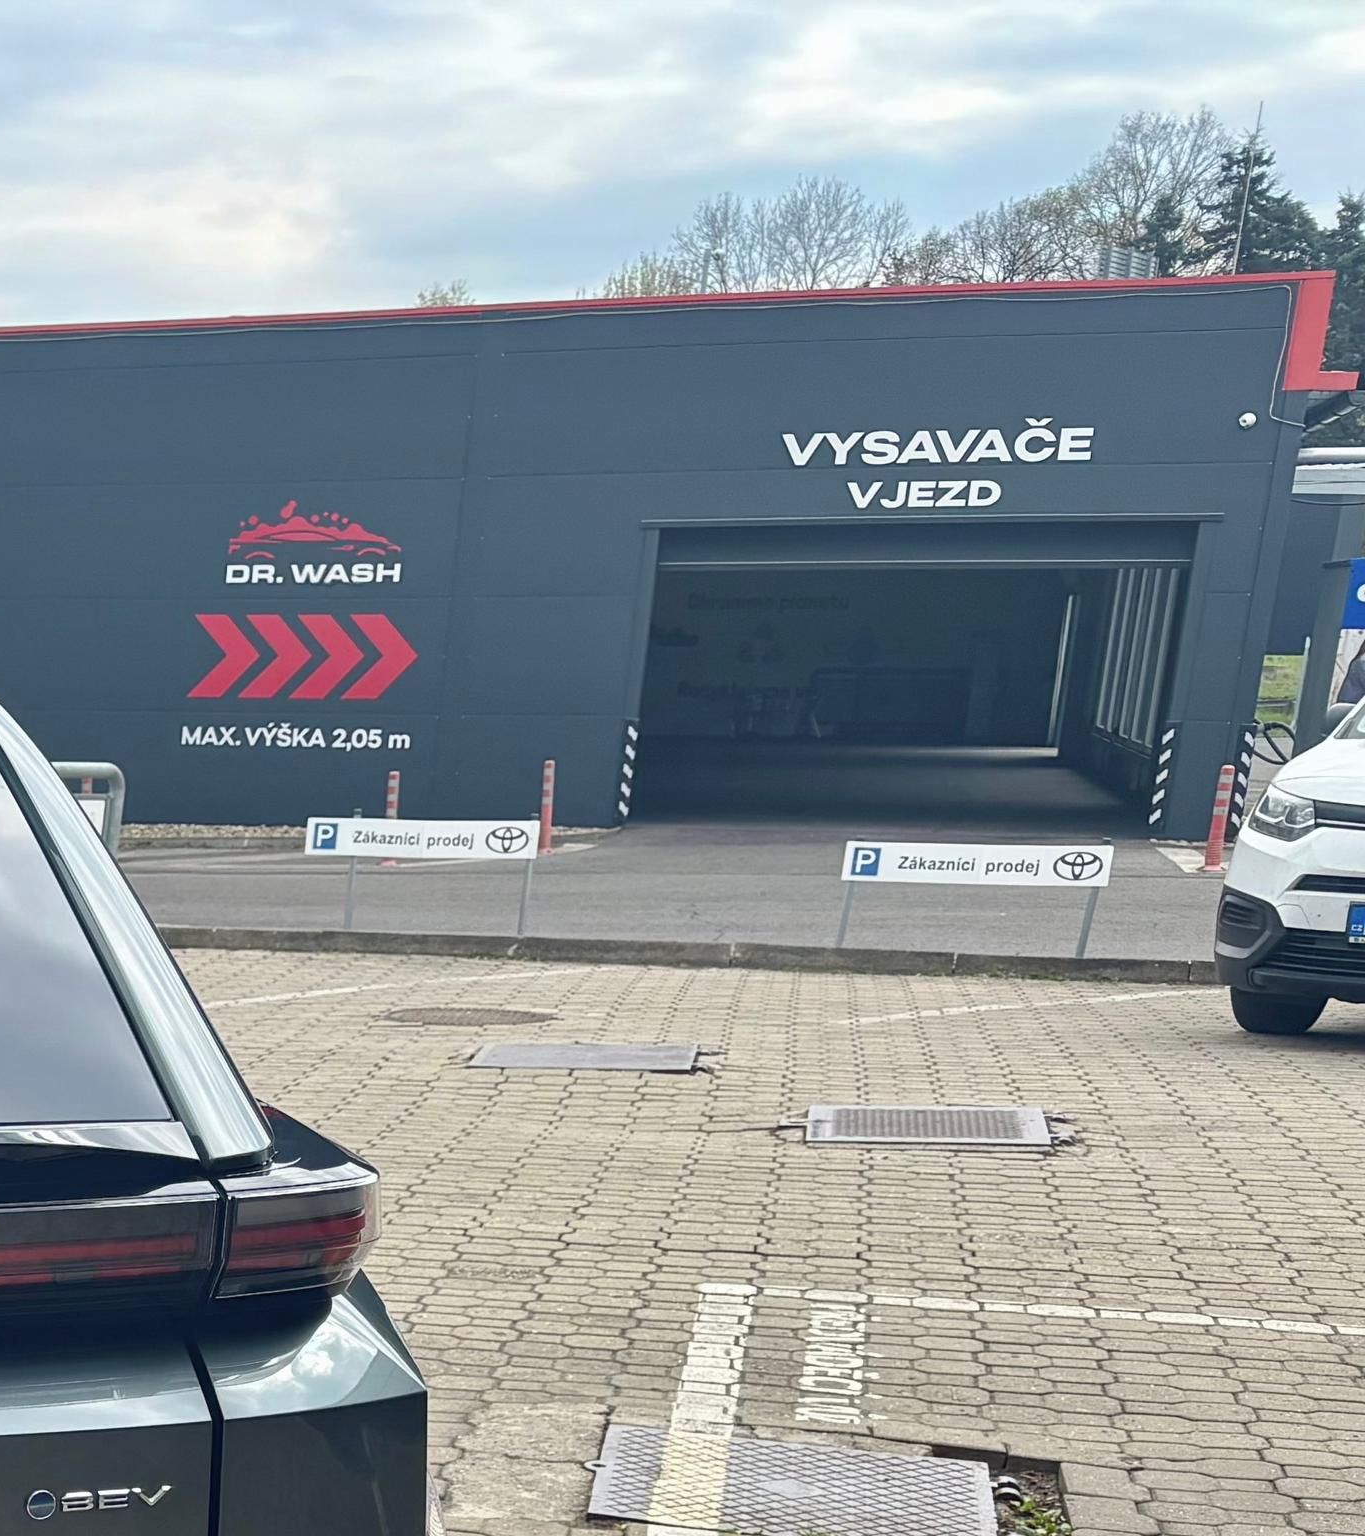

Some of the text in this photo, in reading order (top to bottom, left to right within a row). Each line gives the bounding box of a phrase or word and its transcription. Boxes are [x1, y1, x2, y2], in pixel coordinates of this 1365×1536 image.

[781, 417, 1095, 466] VYSAVAČE
[846, 480, 1003, 509] VJEZD
[225, 563, 402, 584] DR. WASH
[180, 722, 411, 752] MAX. VÝŠKA 2,05 m
[352, 830, 421, 846] Zákazníci
[426, 832, 475, 849] prodej
[897, 855, 976, 872] Zákazníci
[984, 859, 1041, 877] prodej
